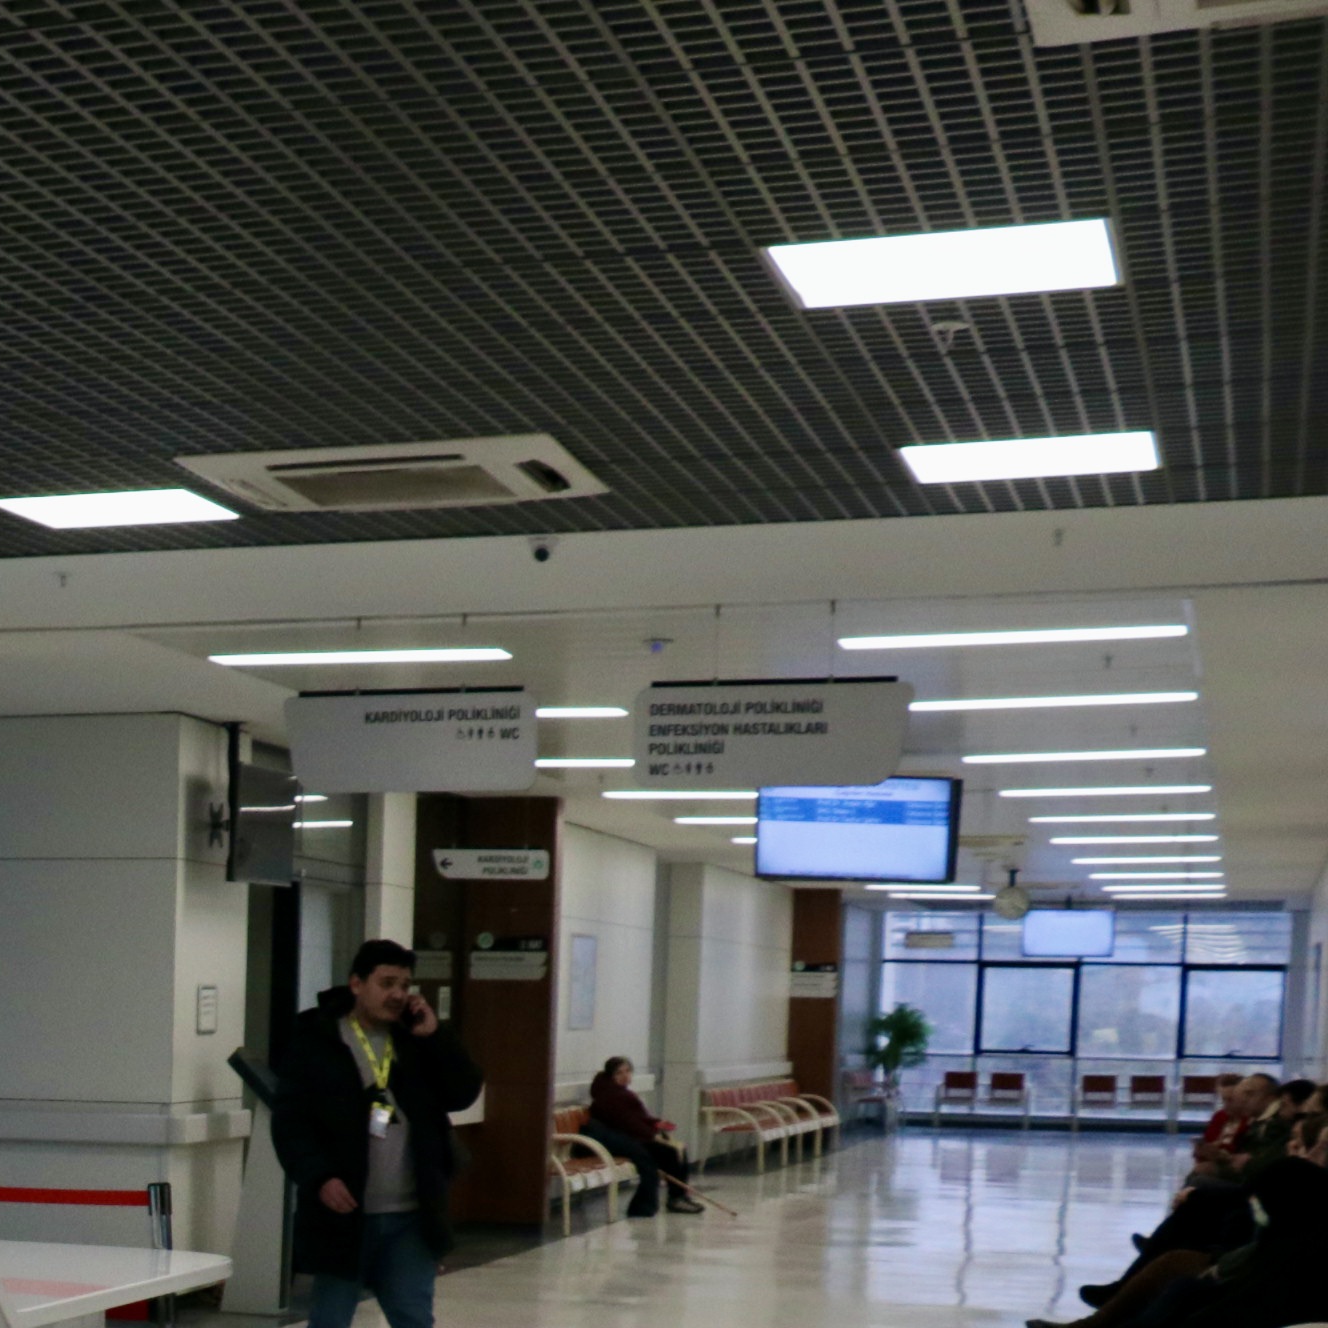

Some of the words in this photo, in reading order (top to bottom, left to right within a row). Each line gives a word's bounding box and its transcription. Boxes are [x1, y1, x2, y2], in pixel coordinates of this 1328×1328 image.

[364, 707, 444, 724] KARDİYOLOJİ
[447, 705, 521, 721] POLİKLİNİĞİ
[649, 700, 741, 717] DERMATOLOJİ
[745, 698, 824, 715] POLİKLİNİĞİ
[499, 727, 520, 740] WC
[648, 721, 730, 737] ENFEKSİYON
[733, 721, 829, 735] HASTALIKLARI
[648, 739, 725, 756] POLİKLİNİĞİ
[648, 763, 670, 776] WC
